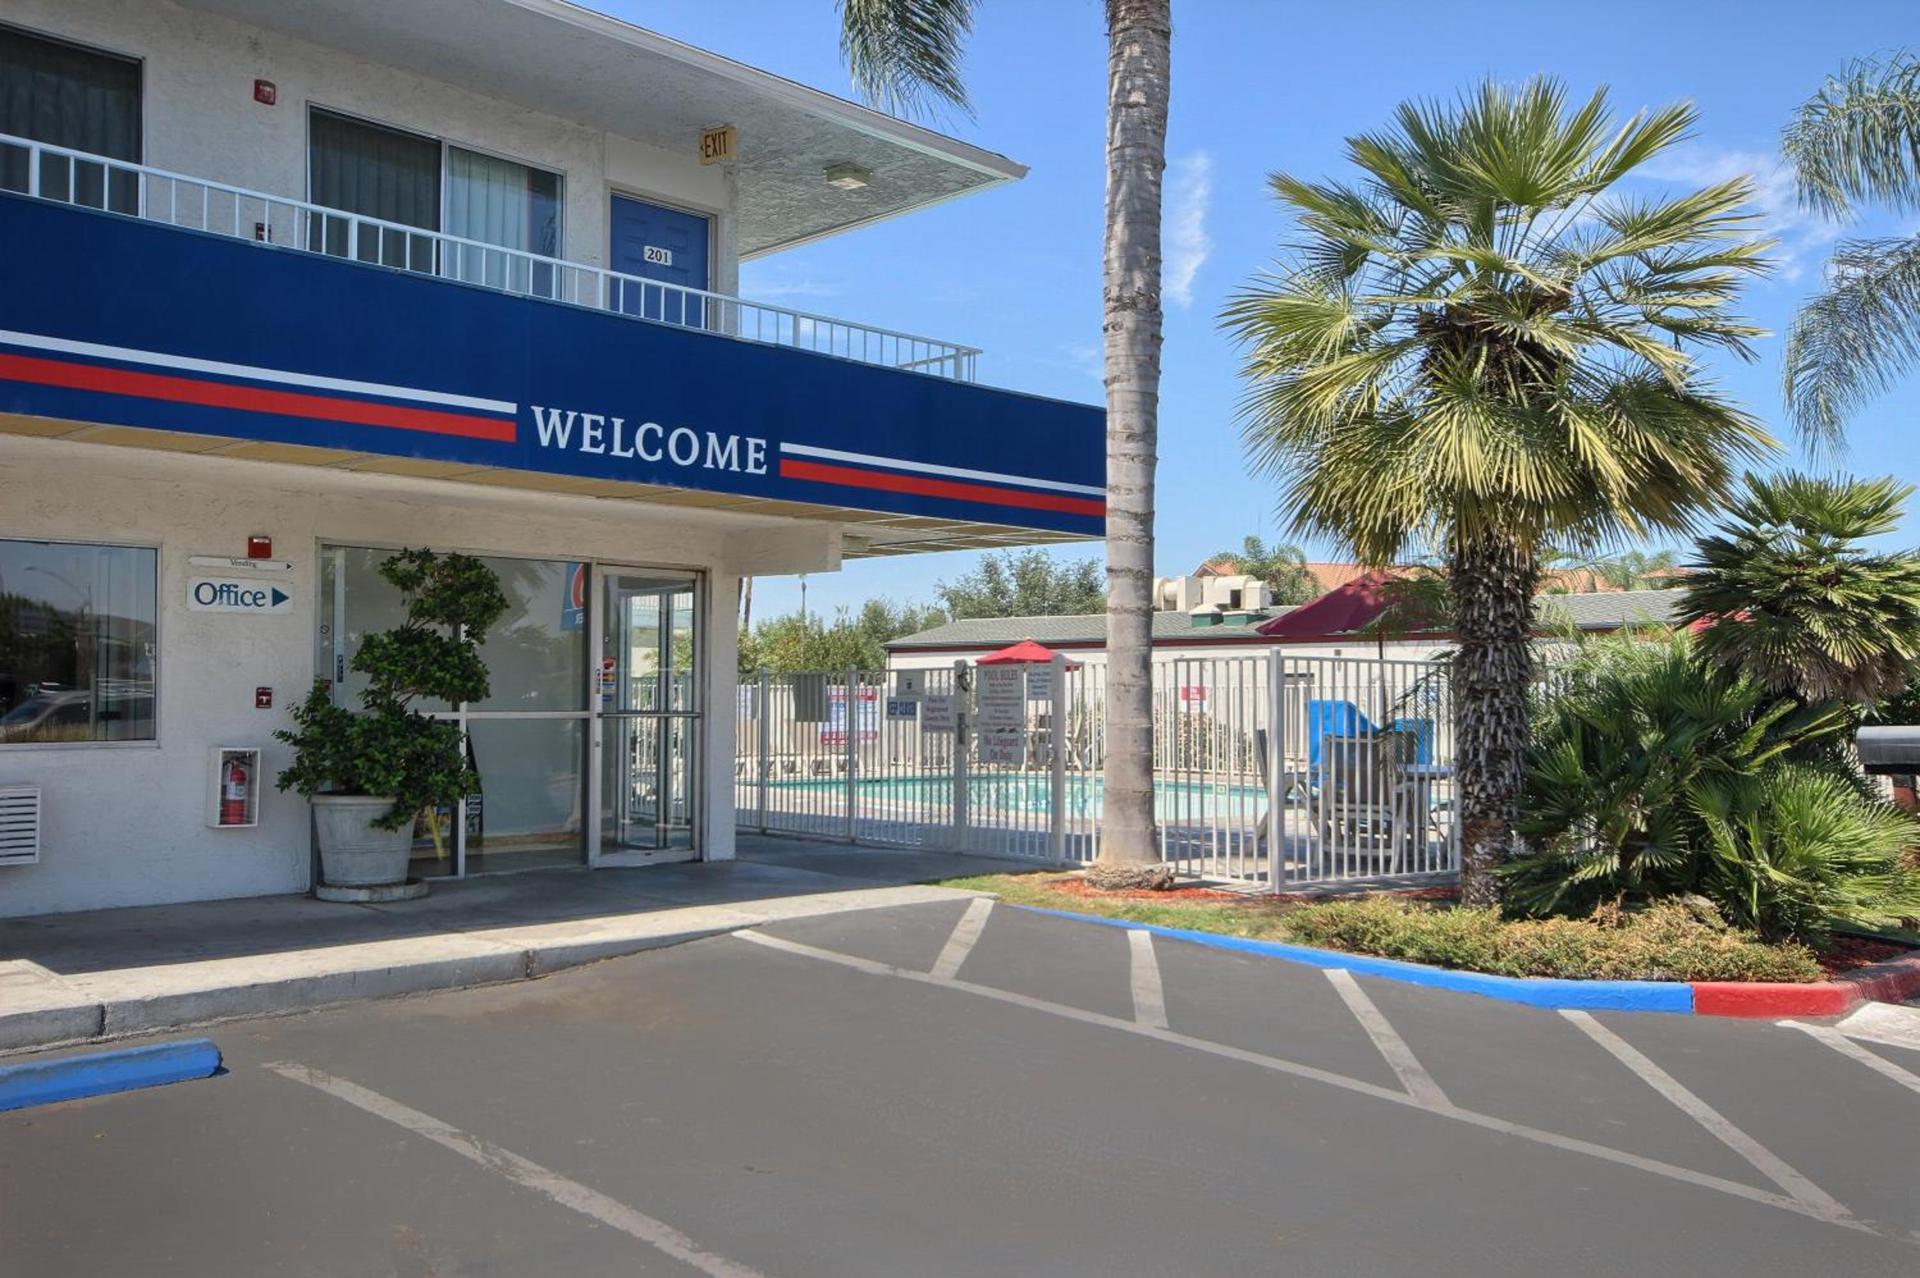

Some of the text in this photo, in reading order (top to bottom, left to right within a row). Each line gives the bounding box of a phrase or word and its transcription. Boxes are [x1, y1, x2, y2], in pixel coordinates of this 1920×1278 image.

[704, 131, 727, 158] EXIT
[647, 248, 668, 263] 201
[531, 405, 767, 475] WELCOME
[230, 559, 256, 569] Vending
[194, 582, 266, 607] Office
